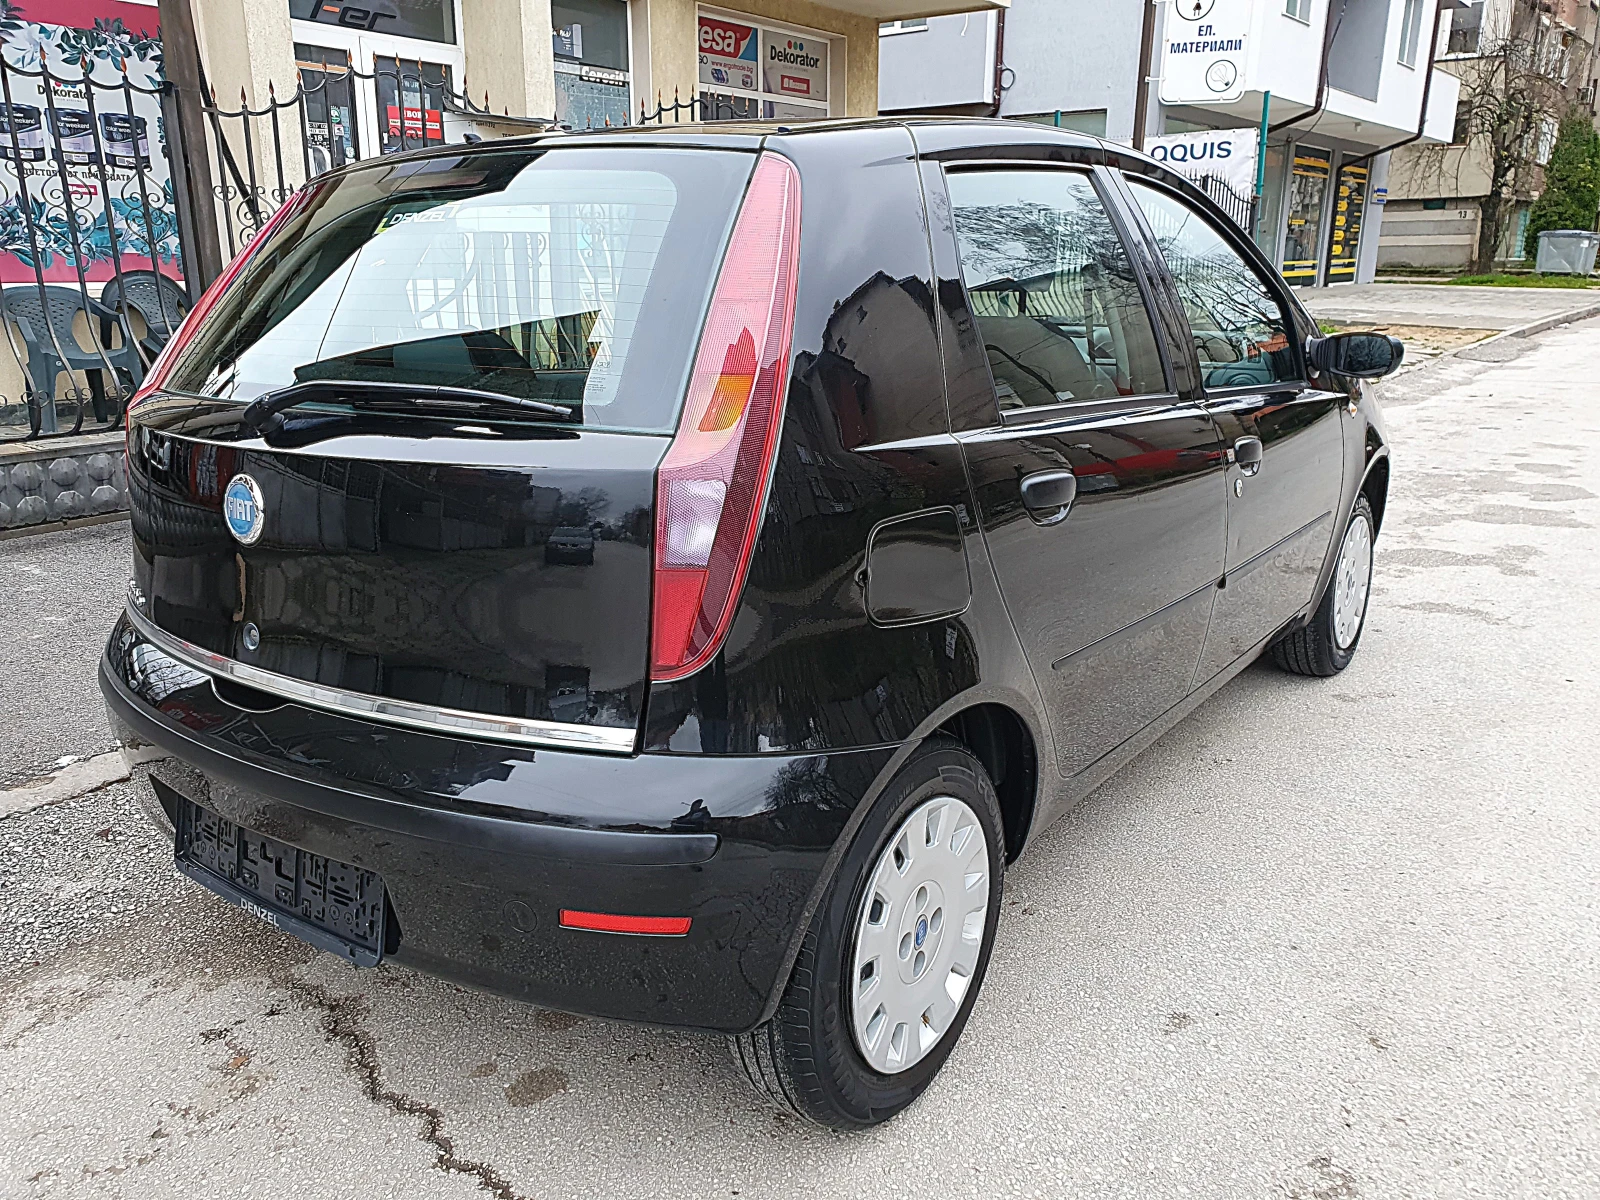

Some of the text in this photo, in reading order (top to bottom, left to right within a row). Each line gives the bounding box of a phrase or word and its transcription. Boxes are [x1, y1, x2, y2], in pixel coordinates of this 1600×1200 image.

[698, 25, 736, 53] esa
[1198, 25, 1216, 36] ЕЛ.
[770, 44, 820, 69] Dekorator
[1170, 39, 1242, 54] МАТЕРИАЛИ
[389, 211, 446, 225] DENZEL
[1458, 210, 1467, 218] 13
[227, 496, 253, 521] FIAT
[240, 897, 280, 927] DENZEL
